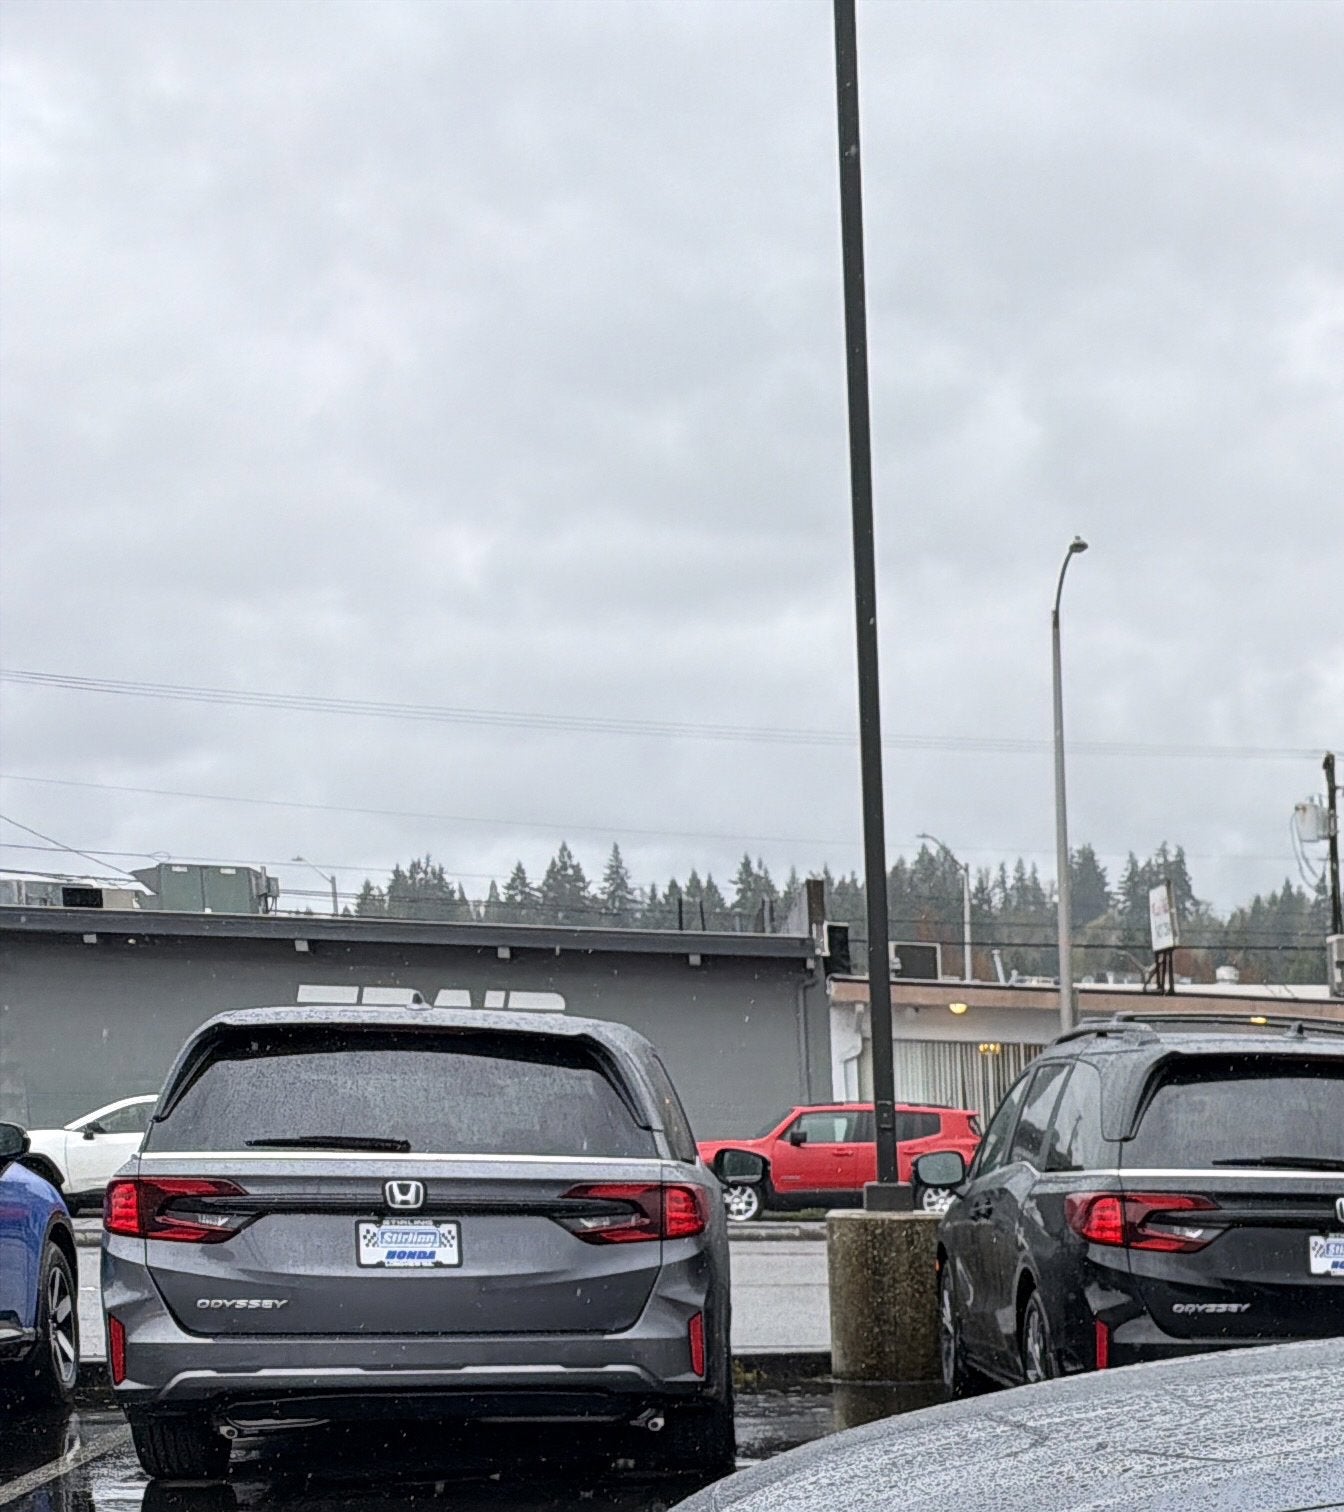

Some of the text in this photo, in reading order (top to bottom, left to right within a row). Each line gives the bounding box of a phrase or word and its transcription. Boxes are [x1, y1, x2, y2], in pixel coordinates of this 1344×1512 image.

[383, 1232, 435, 1248] Stirling
[385, 1250, 436, 1260] HONDA
[196, 1299, 289, 1309] ODYSSEY
[1172, 1303, 1251, 1314] ODYSSEY
